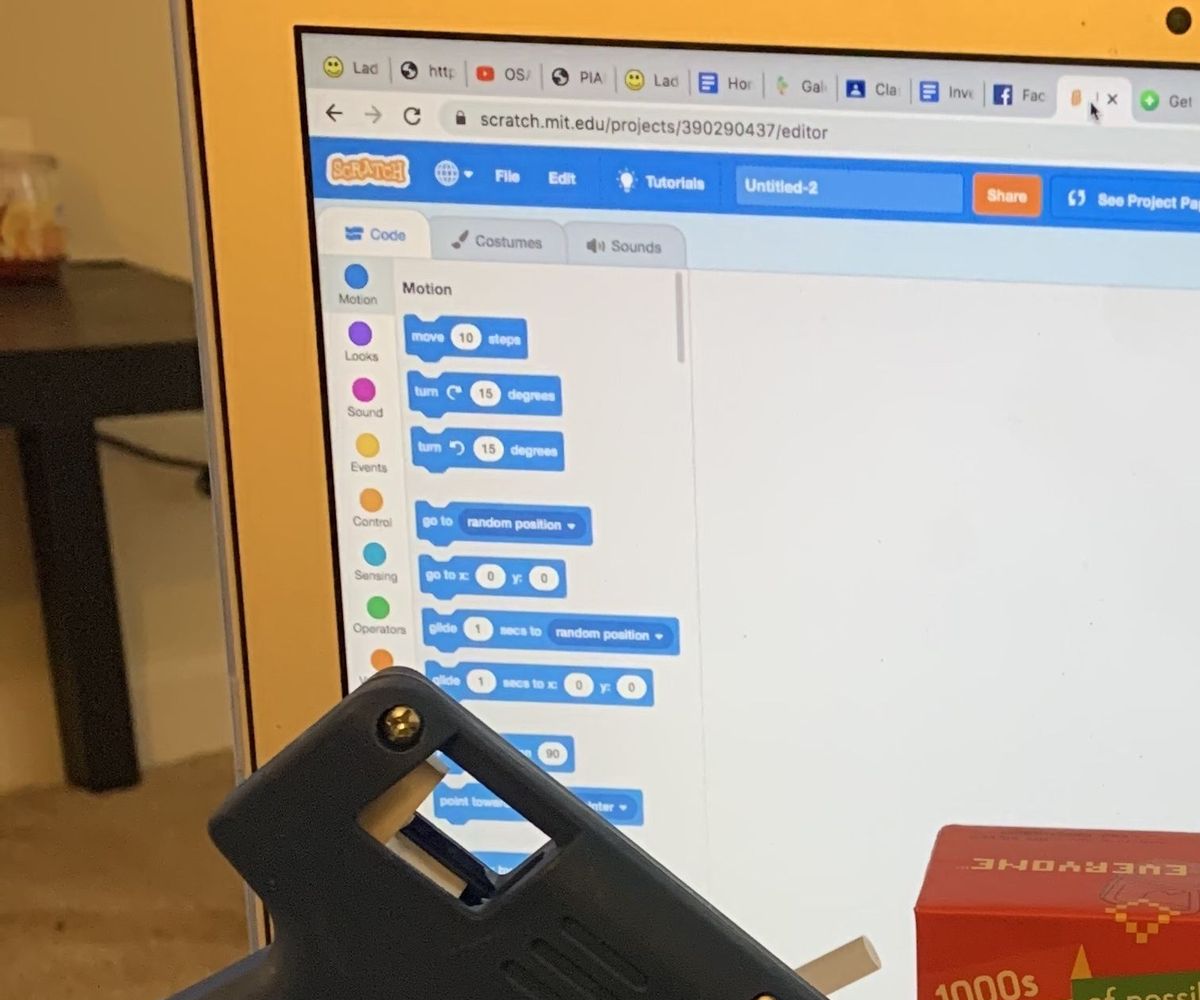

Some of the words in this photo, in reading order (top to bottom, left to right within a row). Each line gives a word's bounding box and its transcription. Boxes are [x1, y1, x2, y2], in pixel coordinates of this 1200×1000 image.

[580, 71, 603, 84] PIA
[1022, 89, 1045, 102] Fac
[1168, 95, 1192, 108] Get
[480, 112, 828, 141] scratch.mit.edu/projects/390290437/editor
[495, 169, 521, 184] File
[549, 171, 577, 186] Edit
[646, 174, 705, 191] Tutorials
[745, 178, 819, 196] Untitled-2
[987, 187, 1028, 204] Share
[1098, 192, 1125, 208] See
[1127, 193, 1177, 213] Project
[370, 227, 407, 242] Code
[475, 234, 543, 250] Costumes
[611, 240, 662, 255] Sounds
[402, 281, 453, 297] Motion
[339, 293, 378, 306] Motion
[411, 331, 445, 343] move
[459, 332, 474, 344] 10
[488, 333, 521, 347] steps
[345, 350, 379, 363] Looks
[414, 385, 439, 397] turn
[479, 388, 493, 400] 15
[507, 389, 555, 404] degrees
[347, 406, 384, 419] Sound
[418, 440, 442, 453] turn
[481, 443, 496, 455] 15
[510, 444, 559, 459] degrees
[350, 461, 388, 475] Events
[353, 515, 392, 528] Control
[422, 517, 438, 529] go
[439, 516, 453, 527] to
[467, 517, 512, 530] random
[515, 518, 562, 533] position
[354, 570, 398, 584] Sensing
[425, 570, 442, 583] go
[443, 570, 457, 581] to
[487, 571, 495, 582] 0
[540, 572, 548, 584] 0
[353, 622, 407, 637] Operators
[428, 622, 457, 637] glide
[500, 626, 527, 637] secs
[528, 625, 542, 637] to
[555, 627, 600, 640] random
[603, 628, 650, 643] position
[503, 679, 531, 690] secs
[532, 678, 546, 690] to
[575, 680, 582, 691] 0
[440, 796, 469, 808] point
